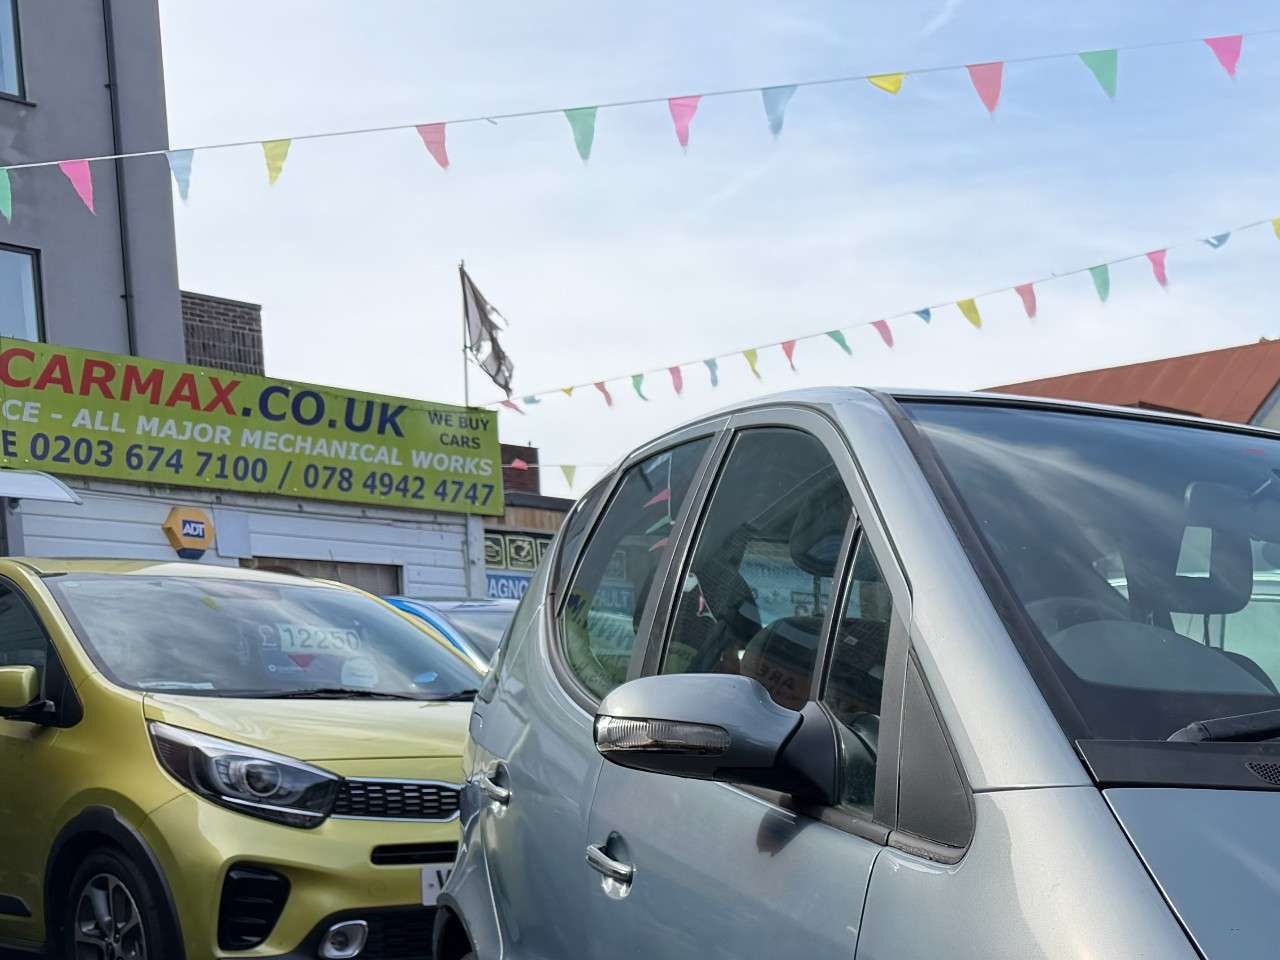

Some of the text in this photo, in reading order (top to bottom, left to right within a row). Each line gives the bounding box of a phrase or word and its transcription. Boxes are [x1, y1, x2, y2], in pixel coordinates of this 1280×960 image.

[428, 411, 489, 431] WE BUY
[72, 408, 126, 433] ALL
[136, 415, 231, 446] MAJOR
[240, 428, 403, 467] MECHANICAL
[411, 449, 493, 477] WORKS
[440, 433, 481, 450] CARS
[30, 432, 114, 468] 0203
[126, 443, 183, 475] 674
[196, 451, 268, 484] 7100
[277, 460, 293, 490] /
[304, 463, 353, 493] 078
[362, 471, 425, 500] 4942
[434, 480, 495, 507] 4747
[183, 521, 205, 537] ADT
